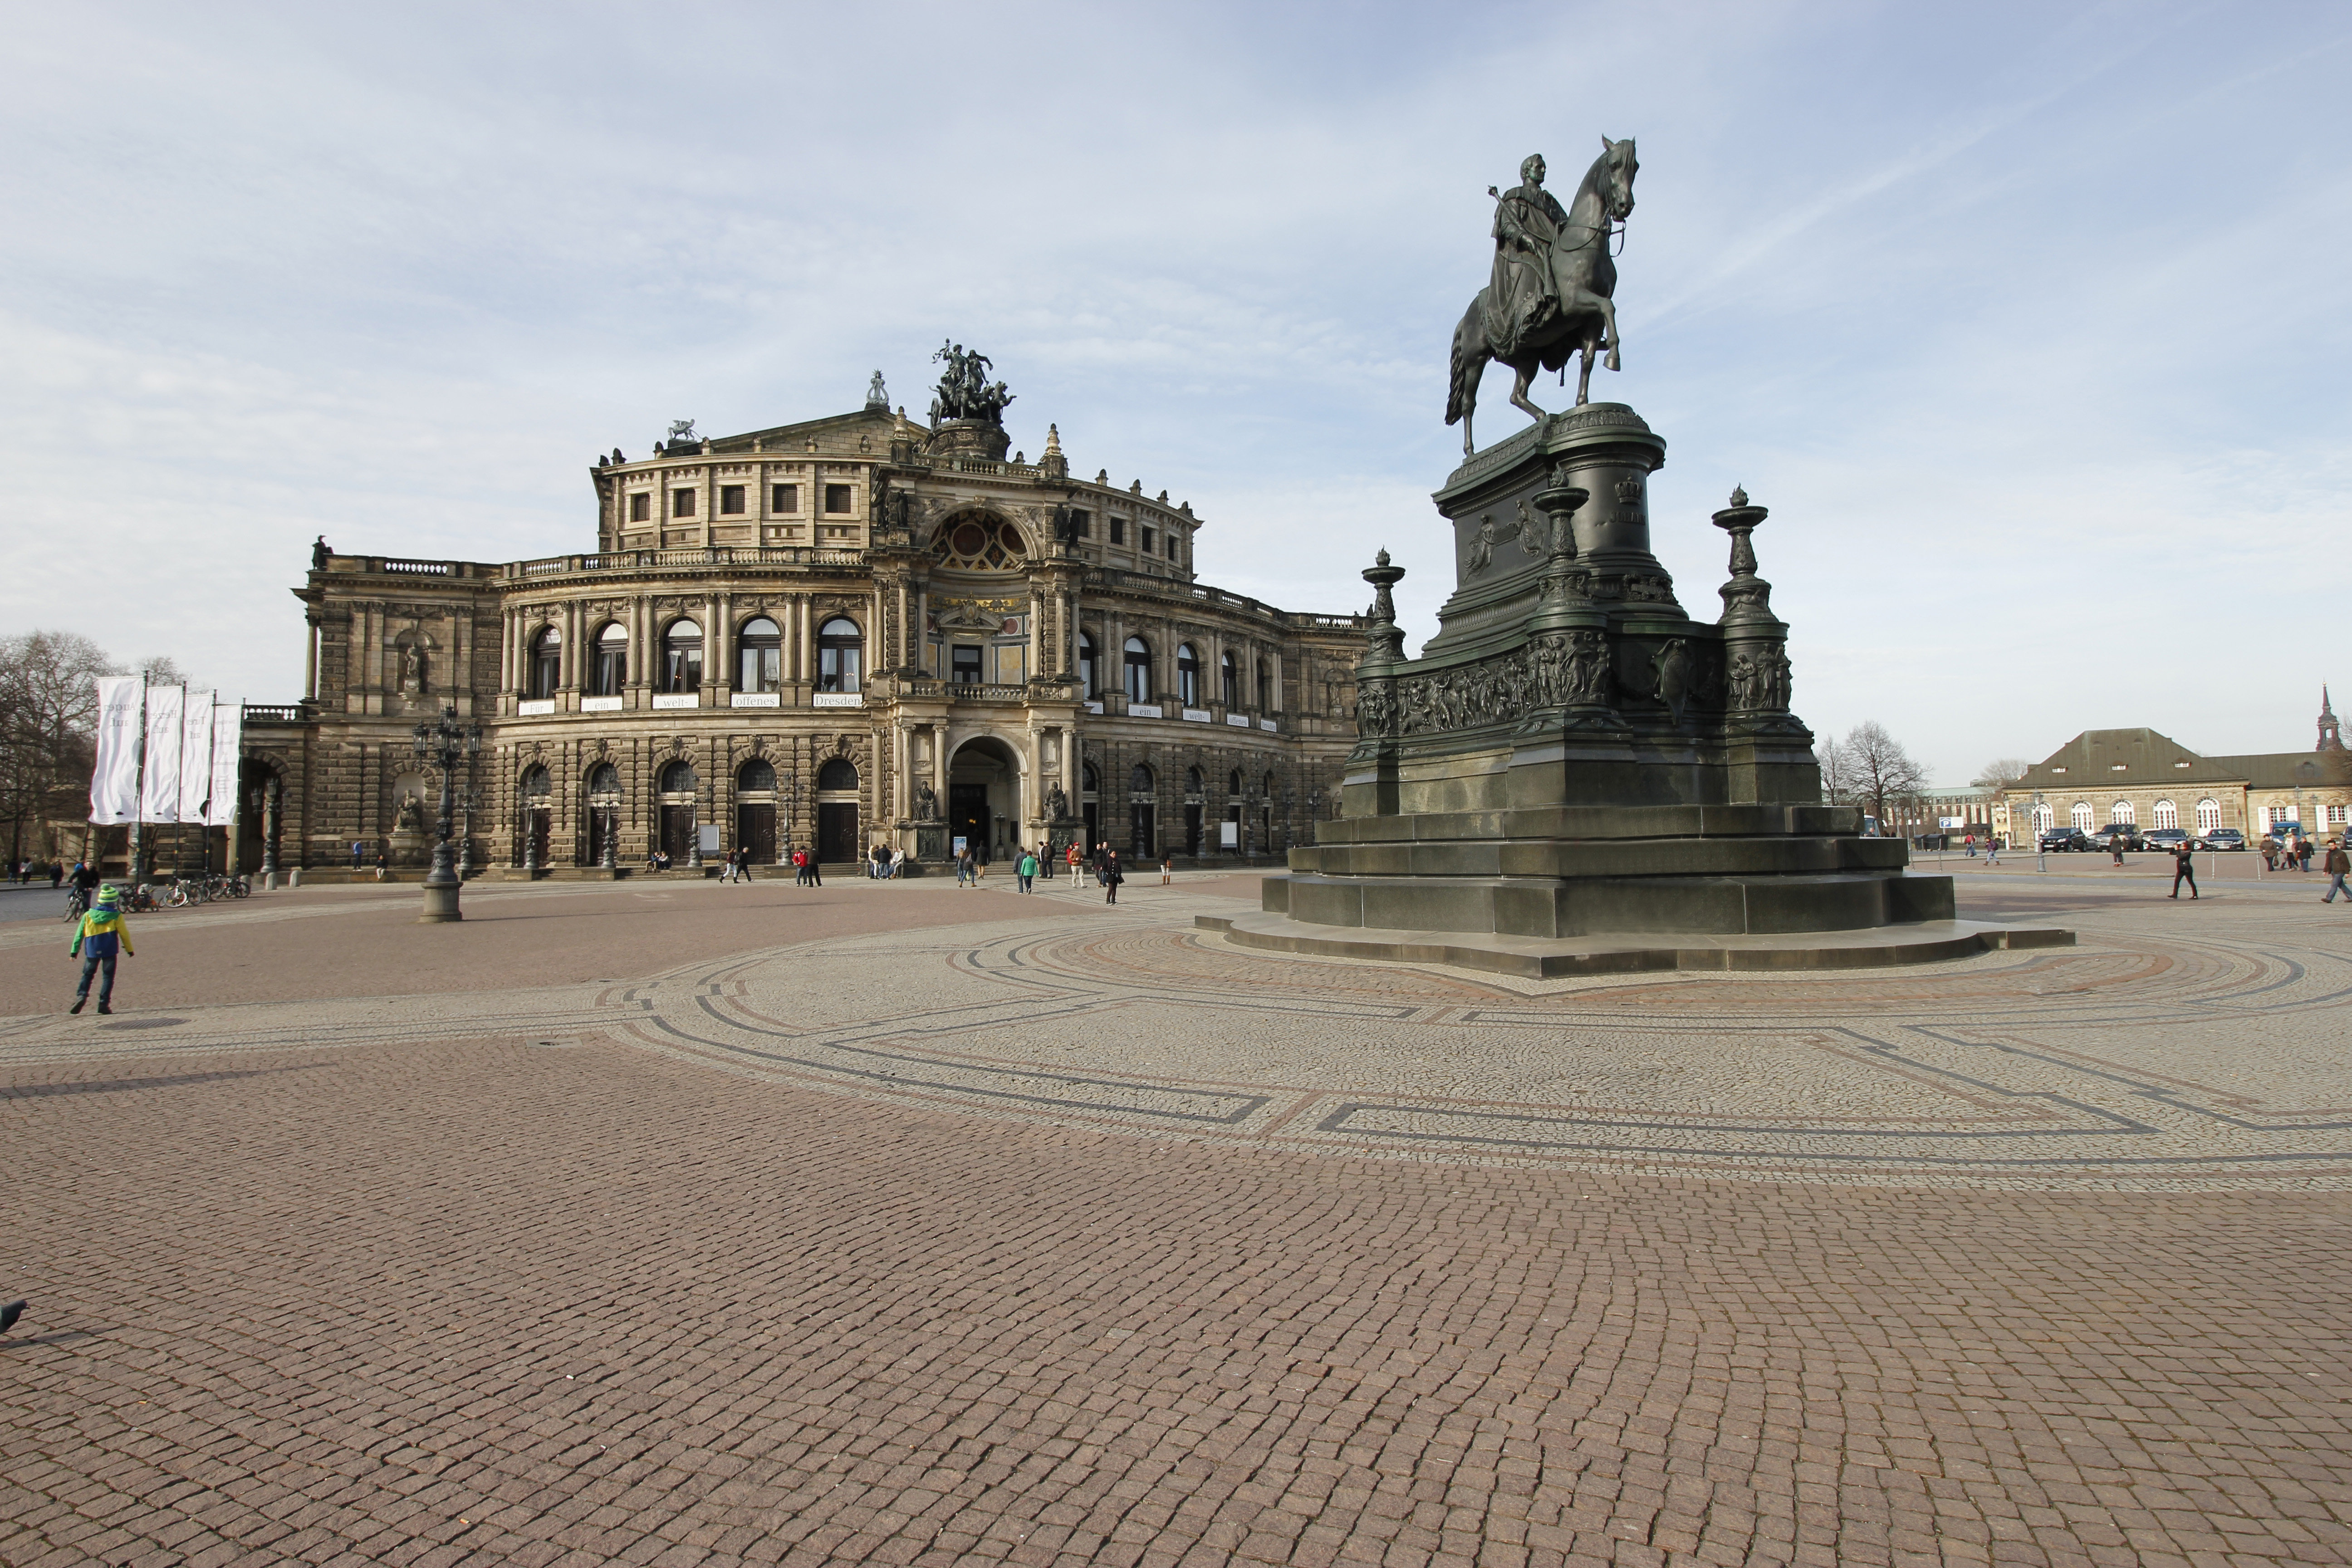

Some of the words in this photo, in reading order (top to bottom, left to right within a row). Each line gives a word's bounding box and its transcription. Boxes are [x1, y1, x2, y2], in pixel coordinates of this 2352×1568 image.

[530, 704, 544, 713] Für
[595, 701, 608, 710] ein
[663, 699, 689, 707] welt-
[736, 696, 775, 706] offenes
[815, 696, 861, 706] Dresden
[1140, 708, 1151, 716] ein
[1189, 712, 1205, 721] welt-
[1229, 717, 1247, 726] offenes
[1262, 722, 1276, 731] Dresden
